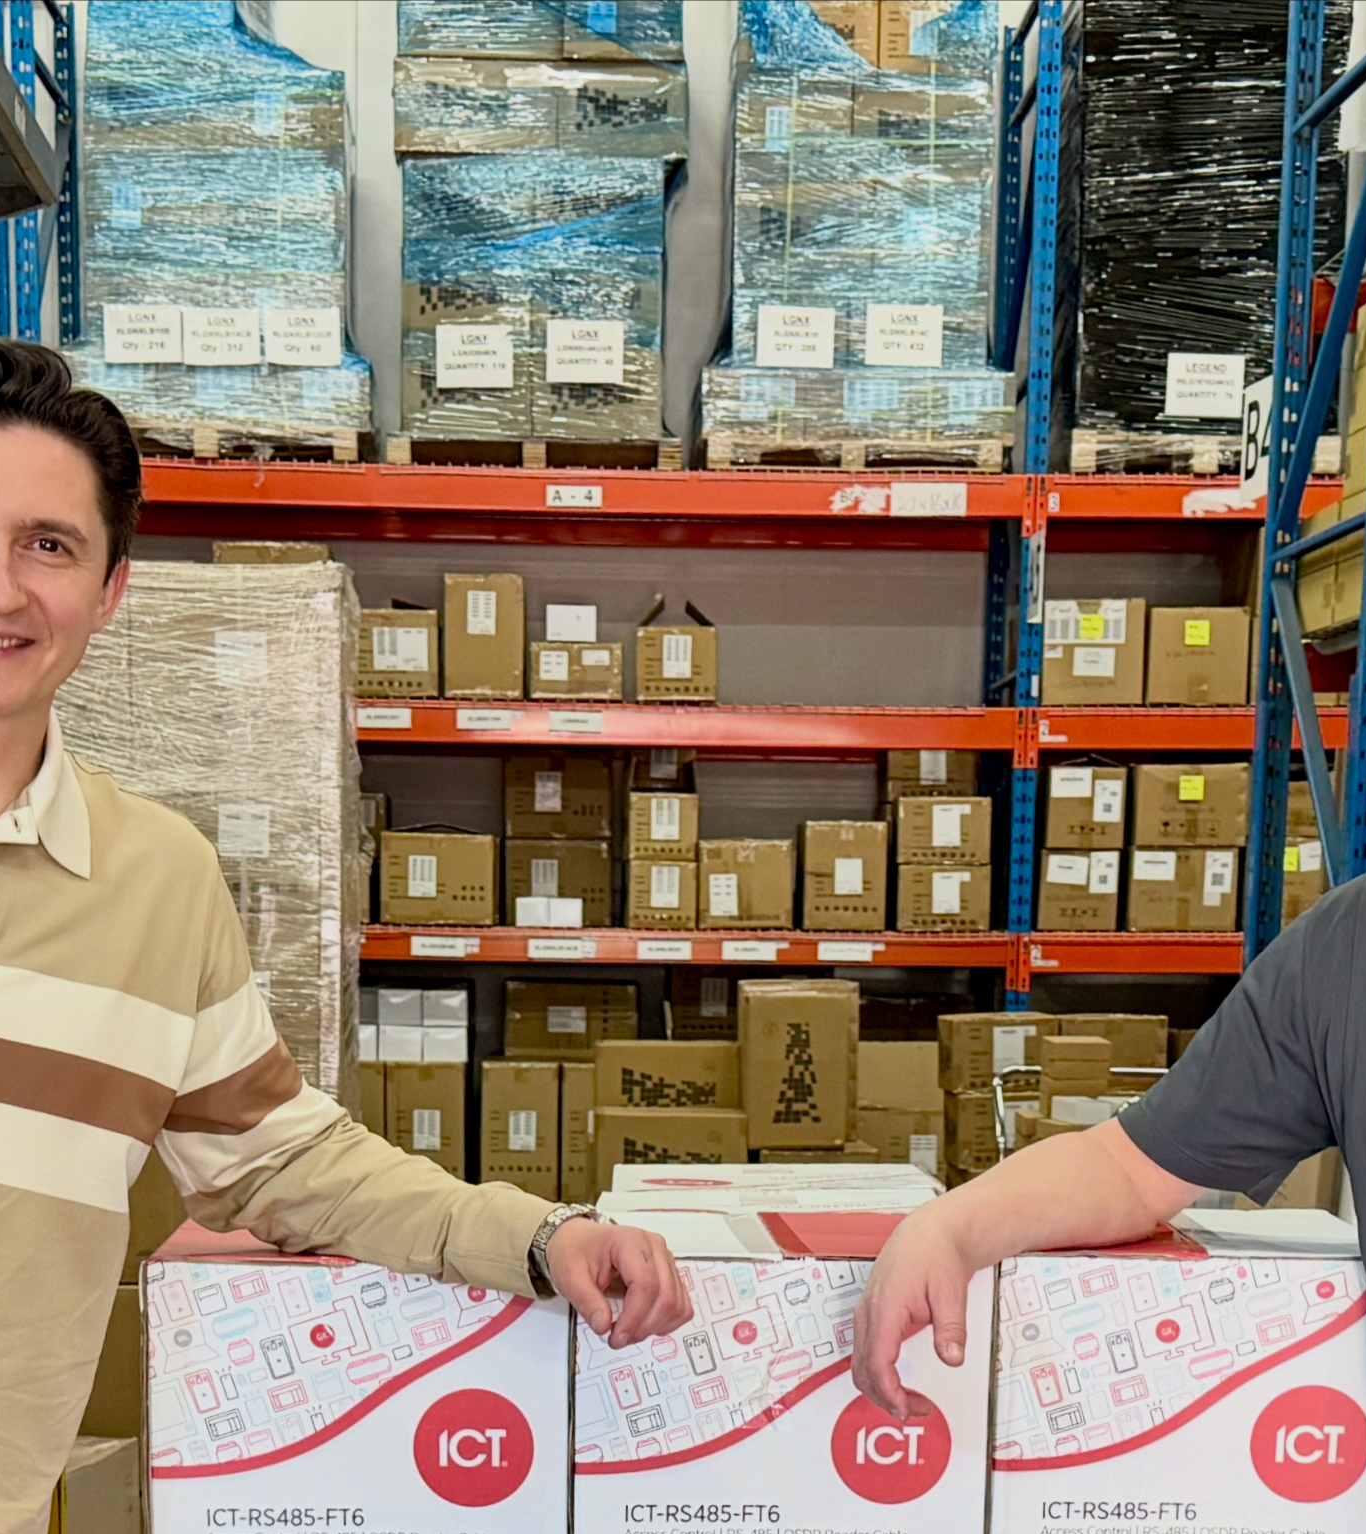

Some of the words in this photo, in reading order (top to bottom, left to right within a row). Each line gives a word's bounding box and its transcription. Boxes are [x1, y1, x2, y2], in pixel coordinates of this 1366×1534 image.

[1185, 363, 1227, 374] LEGEND
[552, 489, 563, 502] A
[584, 489, 593, 502] 4
[206, 1508, 365, 1528] ICT-RS485-FT6
[624, 1504, 780, 1525] ICT-RS485-FT6
[1041, 1501, 1197, 1521] ICT-RS485-FT6
